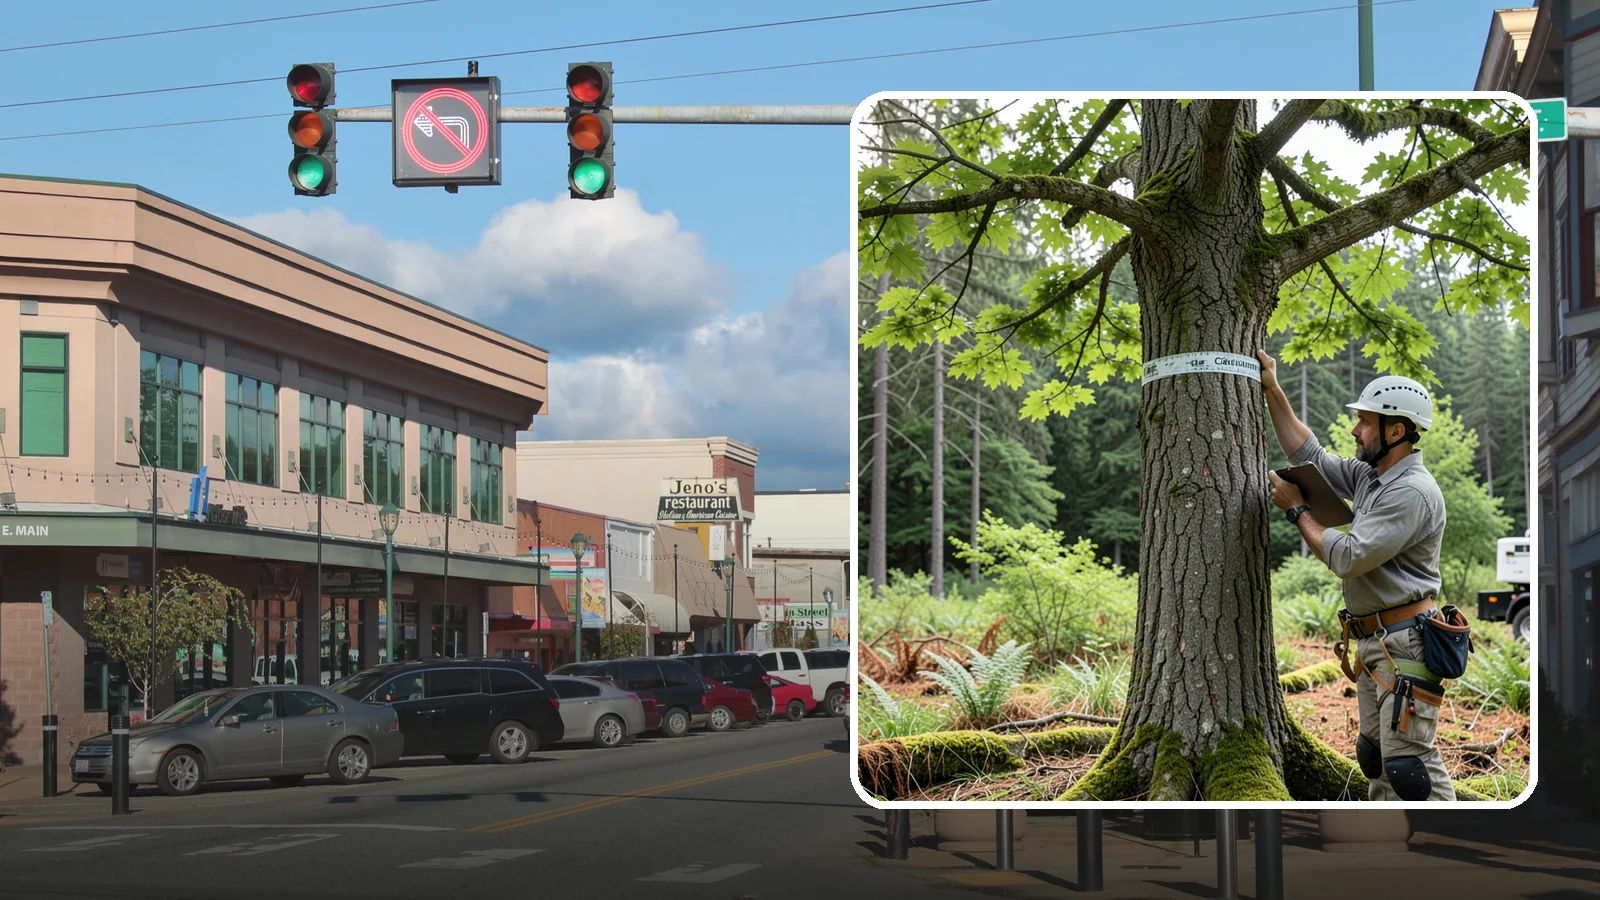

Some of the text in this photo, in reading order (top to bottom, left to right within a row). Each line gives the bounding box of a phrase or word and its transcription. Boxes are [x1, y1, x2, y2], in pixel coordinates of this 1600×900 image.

[670, 480, 727, 494] Jeno's
[665, 496, 731, 509] restaurant
[658, 510, 681, 519] Italian
[685, 510, 714, 519] American
[715, 509, 737, 519] Cuisine
[2, 525, 49, 536] E. MAIN
[797, 607, 829, 617] Street
